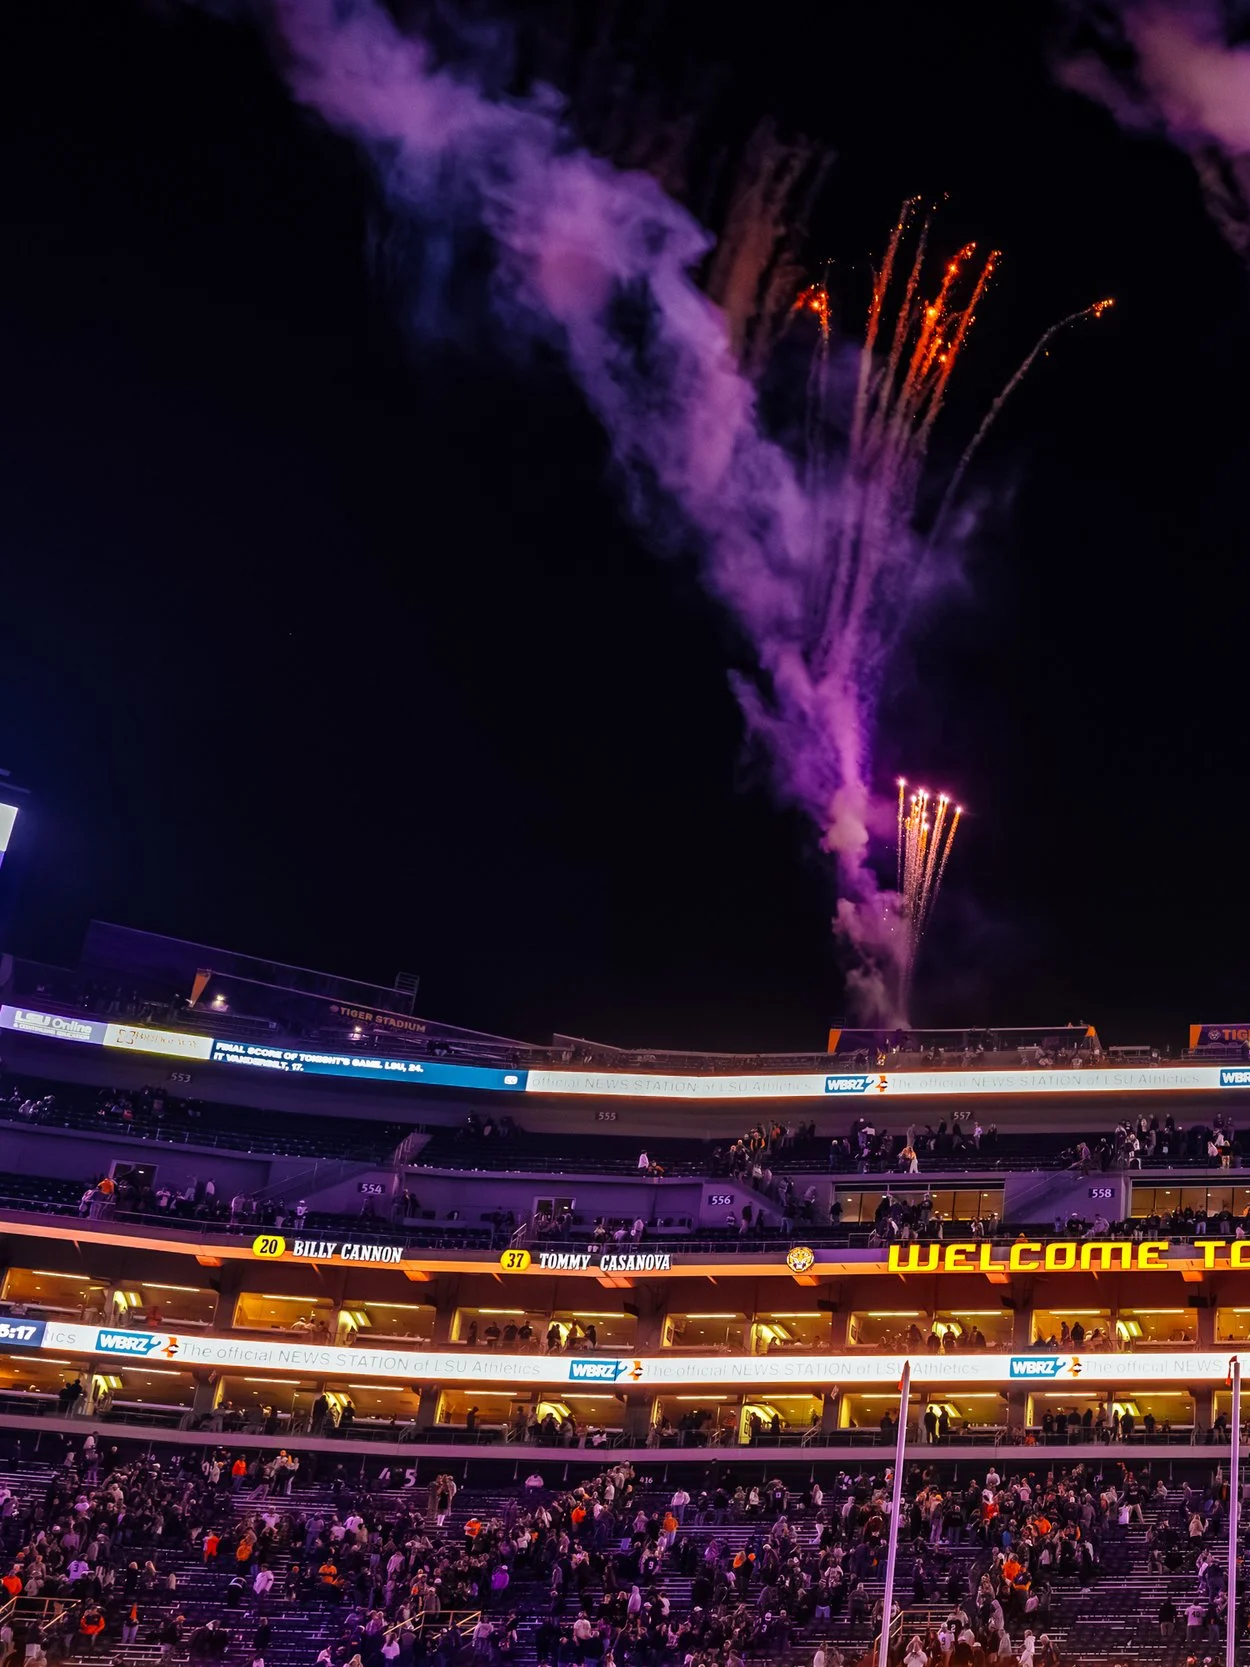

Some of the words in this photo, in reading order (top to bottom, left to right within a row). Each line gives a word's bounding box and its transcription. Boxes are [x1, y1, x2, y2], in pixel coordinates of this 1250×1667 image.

[15, 1010, 51, 1026] LSU
[52, 1018, 93, 1034] Online
[340, 1006, 373, 1022] TIGER
[375, 1013, 426, 1034] STADIUM
[216, 1042, 245, 1054] FINAL
[247, 1046, 283, 1059] SCORE
[283, 1051, 298, 1060] OF
[170, 1072, 192, 1083] 553
[585, 1077, 631, 1091] NEWS
[634, 1078, 697, 1093] STATION
[719, 1079, 748, 1093] LSU
[828, 1077, 866, 1091] WBRZ
[971, 1076, 1014, 1088] NEWS
[1020, 1075, 1081, 1088] STATION
[1104, 1073, 1133, 1085] LSU
[598, 1111, 617, 1121] 555
[953, 1111, 972, 1121] 557
[361, 1183, 382, 1194] 554
[1091, 1188, 1112, 1198] 558
[711, 1195, 731, 1205] 556
[259, 1238, 279, 1255] 20
[292, 1239, 337, 1260] BILLY
[340, 1243, 404, 1264] CANNON
[888, 1240, 1169, 1272] WELCOME
[507, 1252, 524, 1269] 37
[538, 1252, 591, 1271] TOMMY
[600, 1253, 672, 1271] CASANOVA
[100, 1333, 149, 1352] WBRZ
[182, 1343, 211, 1357] The
[216, 1345, 272, 1361] official
[277, 1348, 330, 1365] NEWS
[336, 1353, 408, 1371] STATION
[413, 1357, 429, 1371] of
[435, 1358, 467, 1373] LSU
[472, 1360, 541, 1375] Athletics
[573, 1363, 616, 1378] WBRZ
[645, 1363, 673, 1377] The
[676, 1363, 726, 1377] official
[732, 1363, 780, 1376] NEWS
[784, 1362, 852, 1376] STATION
[912, 1361, 980, 1375] Athletics
[1013, 1360, 1055, 1374] WBRZ
[1173, 1360, 1222, 1373] NEWS
[639, 1475, 654, 1484] 416
